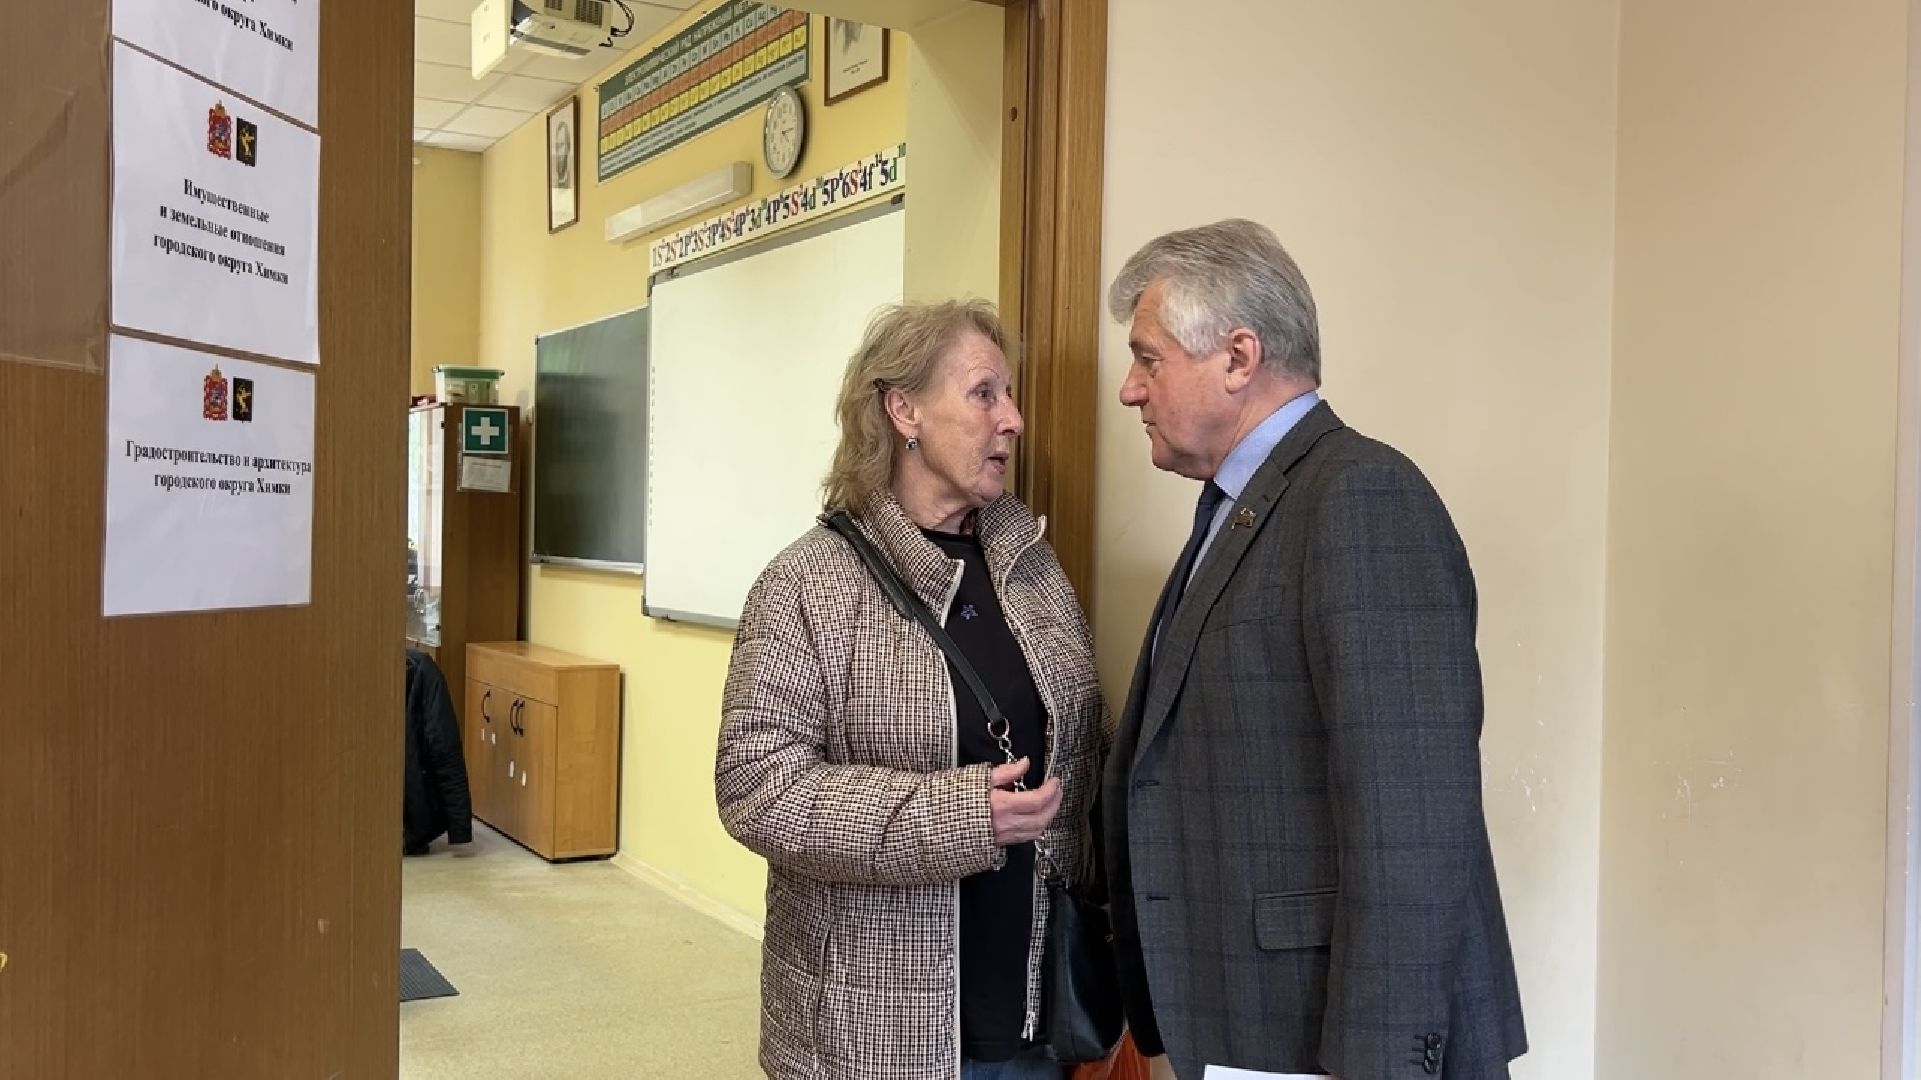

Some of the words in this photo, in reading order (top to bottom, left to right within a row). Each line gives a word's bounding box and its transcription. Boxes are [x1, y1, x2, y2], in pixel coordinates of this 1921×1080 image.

[221, 4, 257, 32] округа
[259, 20, 294, 52] Химки
[184, 179, 270, 222] Имущественные
[160, 205, 168, 218] и
[170, 208, 228, 239] земельные
[230, 229, 286, 256] отношения
[154, 234, 216, 264] городского
[217, 254, 253, 275] округа
[255, 260, 289, 285] Химки
[126, 440, 241, 465] Градостроительство
[243, 455, 250, 468] и
[251, 457, 312, 476] архитектура
[154, 473, 216, 491] городского
[218, 480, 255, 496] округа
[256, 477, 291, 496] Химки
